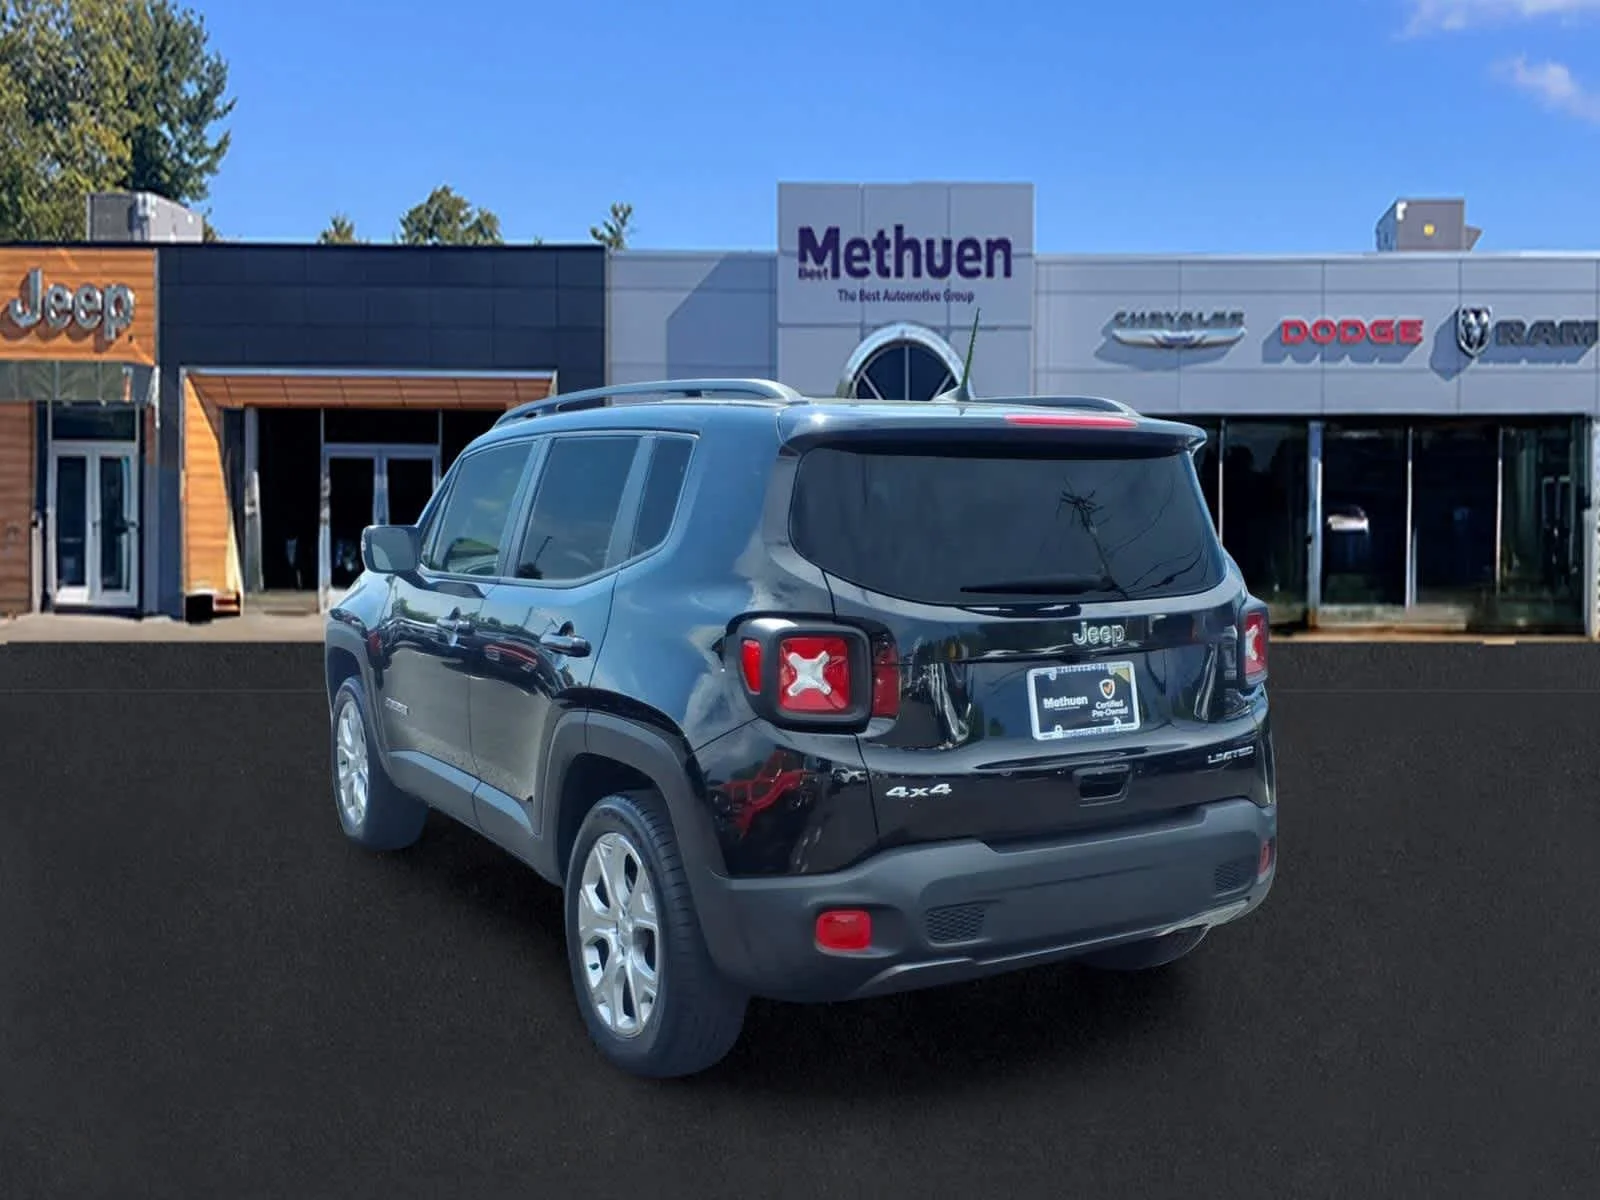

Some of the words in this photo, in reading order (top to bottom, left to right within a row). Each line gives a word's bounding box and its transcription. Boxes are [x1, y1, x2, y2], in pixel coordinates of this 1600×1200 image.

[798, 224, 1012, 279] Methuen
[9, 268, 135, 341] Jeep
[838, 288, 857, 302] The
[859, 288, 880, 302] Best
[883, 288, 941, 302] Automotive
[943, 288, 975, 304] Group
[1114, 311, 1245, 327] CHRYSLER
[1281, 319, 1424, 344] DODGE
[1495, 320, 1599, 346] RAM
[1072, 621, 1125, 648] Jeep
[1043, 696, 1089, 709] Methuen
[886, 783, 952, 798] 4x4
